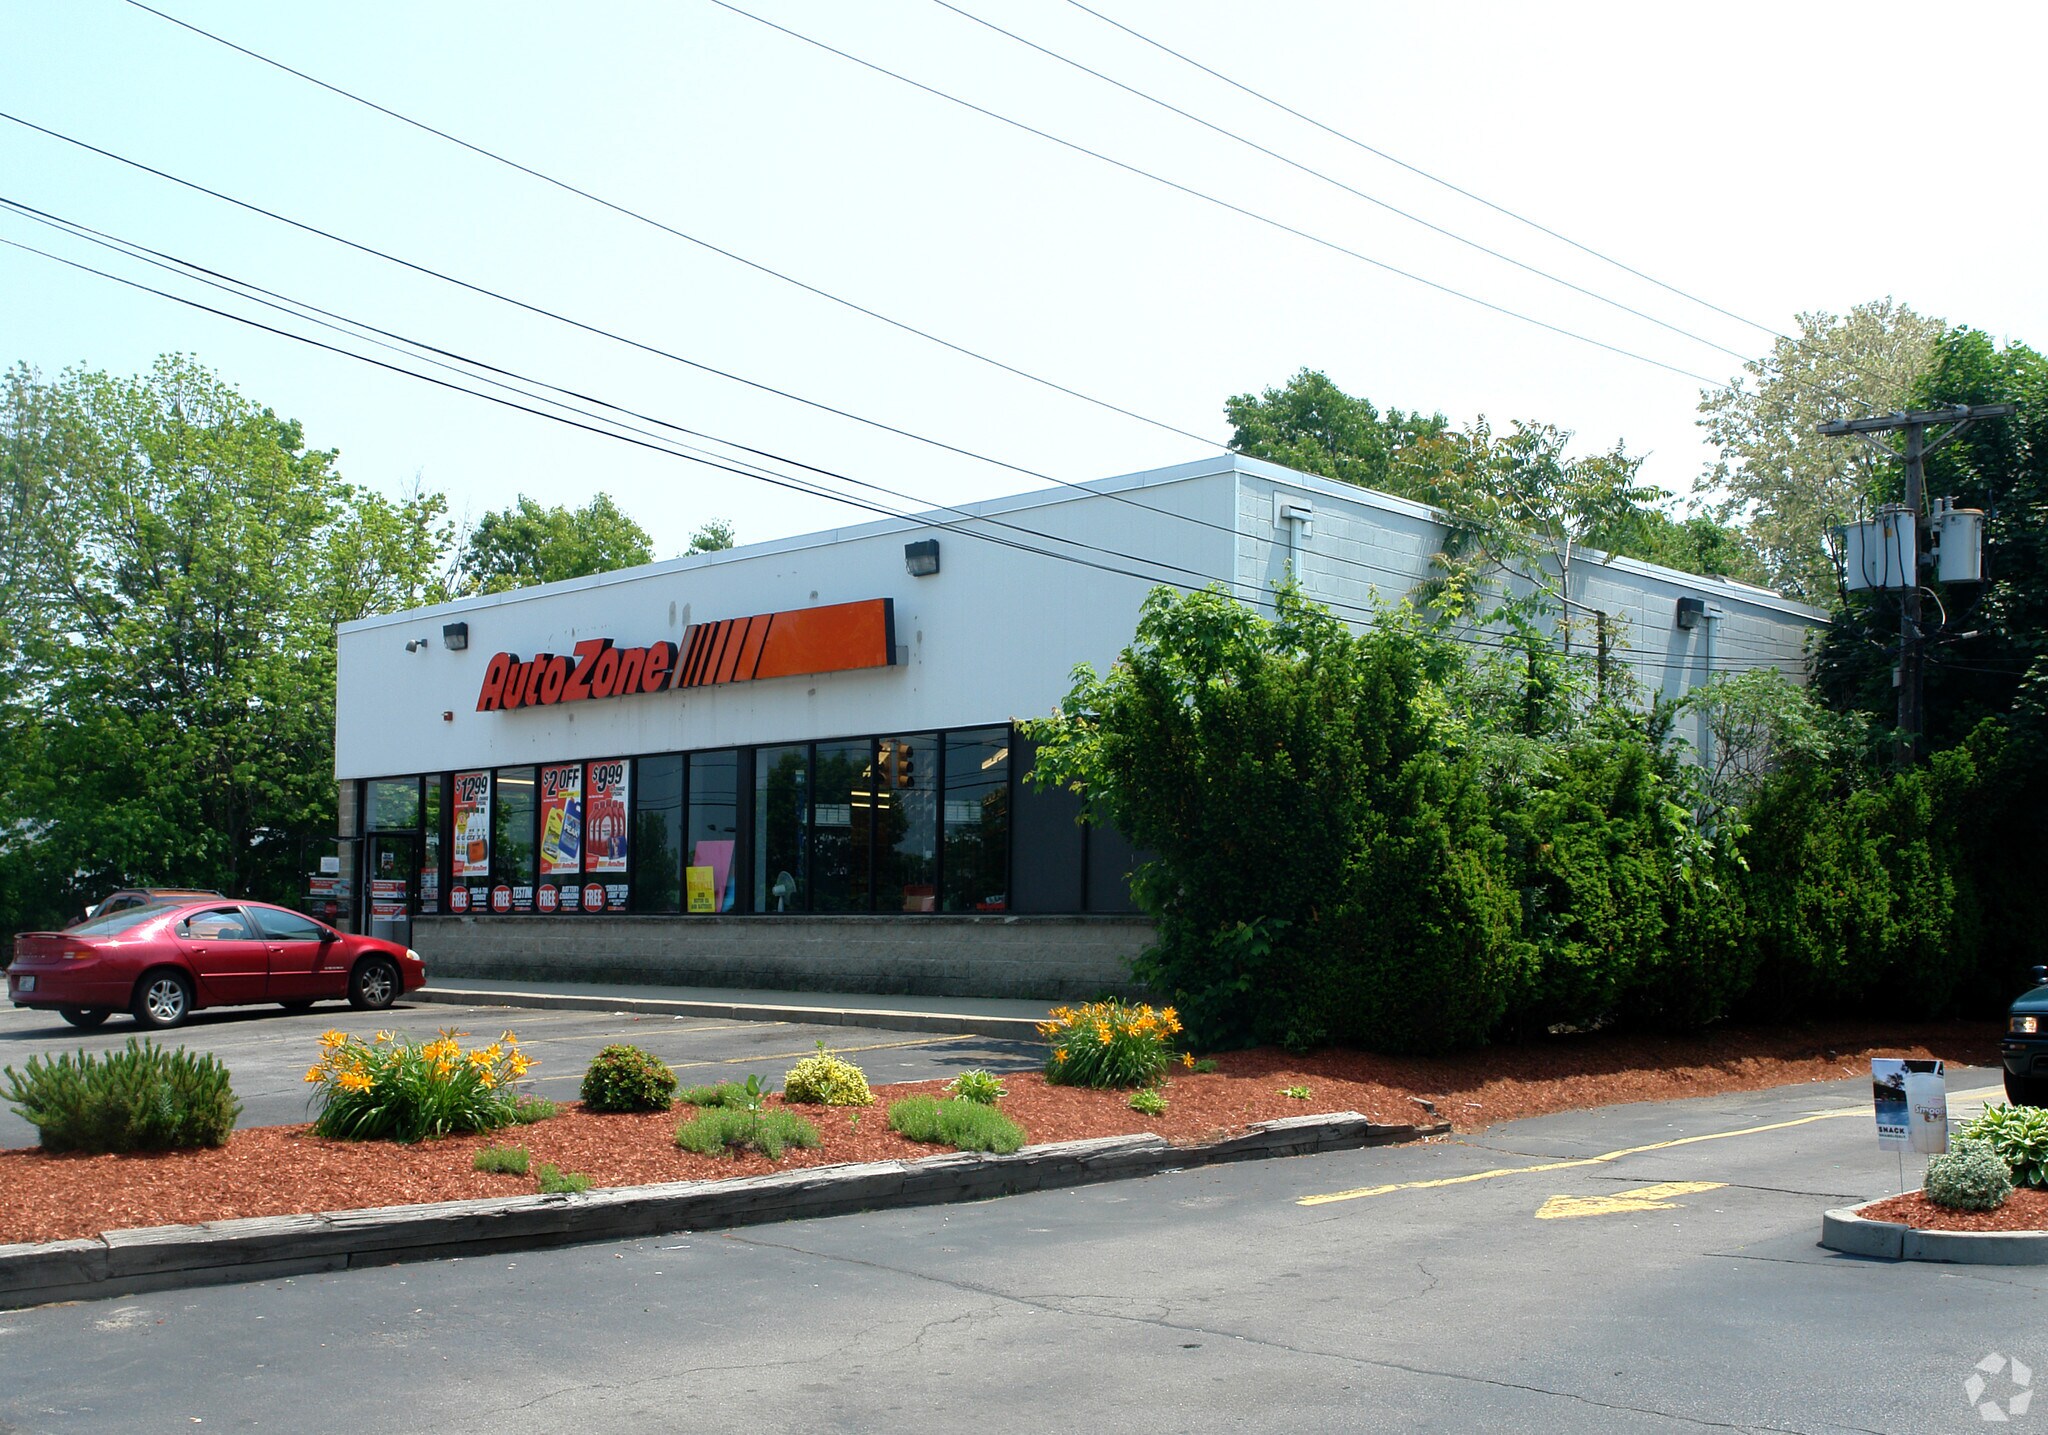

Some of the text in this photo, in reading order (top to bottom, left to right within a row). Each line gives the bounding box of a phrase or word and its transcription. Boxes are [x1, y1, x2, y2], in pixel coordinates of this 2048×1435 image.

[476, 638, 678, 712] AutoZone
[543, 767, 580, 796] $2 OFF
[564, 822, 579, 838] PEAK
[451, 891, 467, 908] FREE
[494, 890, 510, 907] FREE
[539, 889, 556, 907] FREE
[585, 889, 602, 906] FREE
[1878, 1126, 1905, 1134] SNACK
